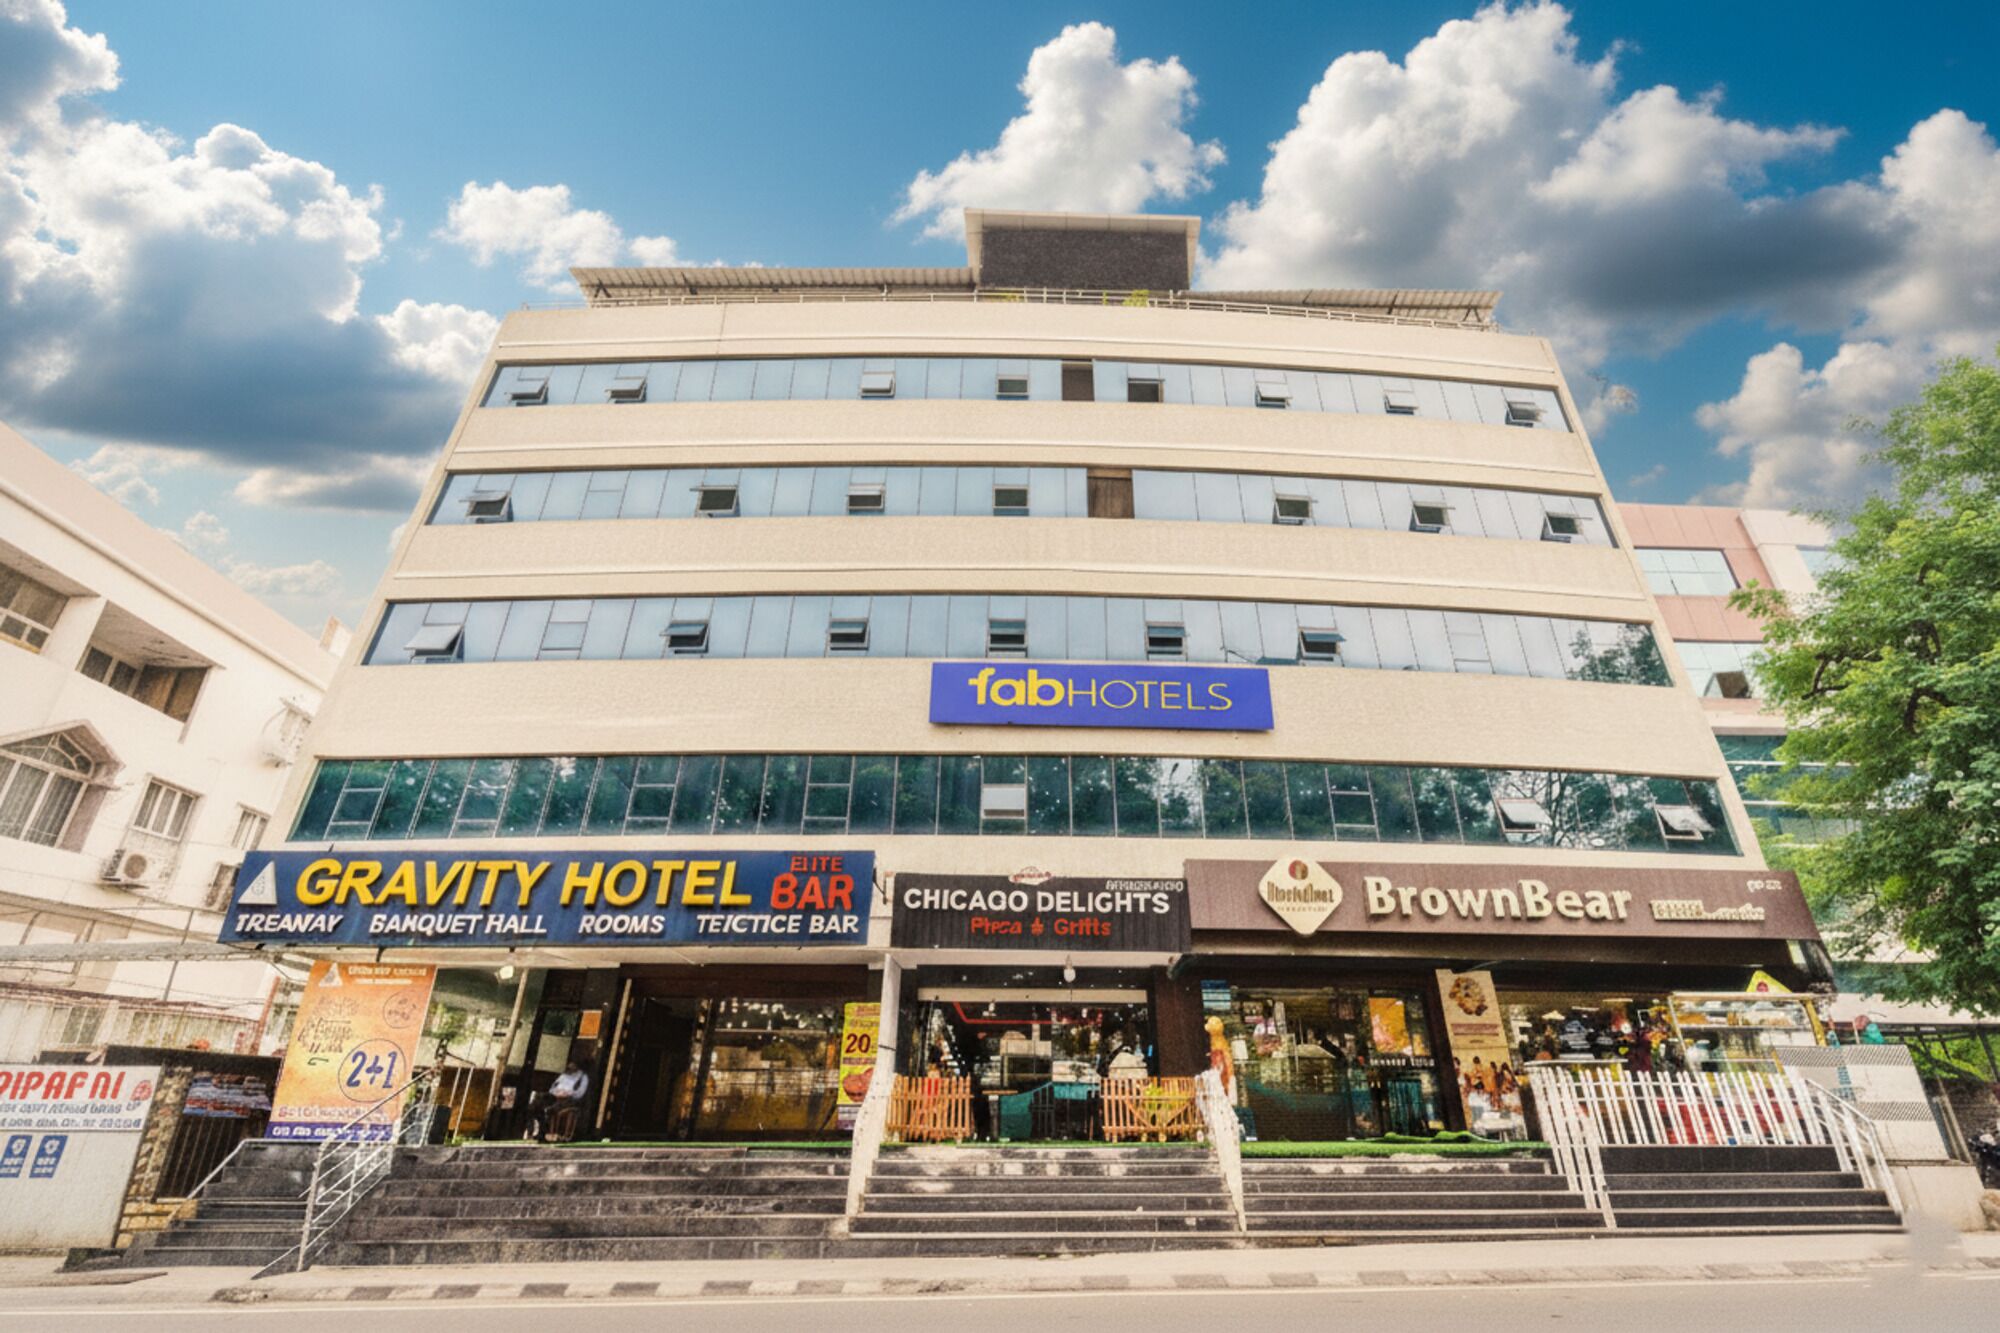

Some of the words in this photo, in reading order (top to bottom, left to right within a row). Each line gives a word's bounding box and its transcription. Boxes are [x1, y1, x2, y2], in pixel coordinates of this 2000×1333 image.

[295, 858, 551, 906] GRAVITY
[559, 859, 752, 906] HOTEL
[770, 872, 854, 911] BAR
[1363, 875, 1632, 921] BrownBear
[903, 888, 1029, 912] CHICAGO
[1036, 890, 1170, 914] DELIGHTS
[484, 913, 547, 934] HALL
[578, 914, 665, 934] ROOMS
[808, 914, 859, 934] BAR
[845, 1033, 871, 1054] 20
